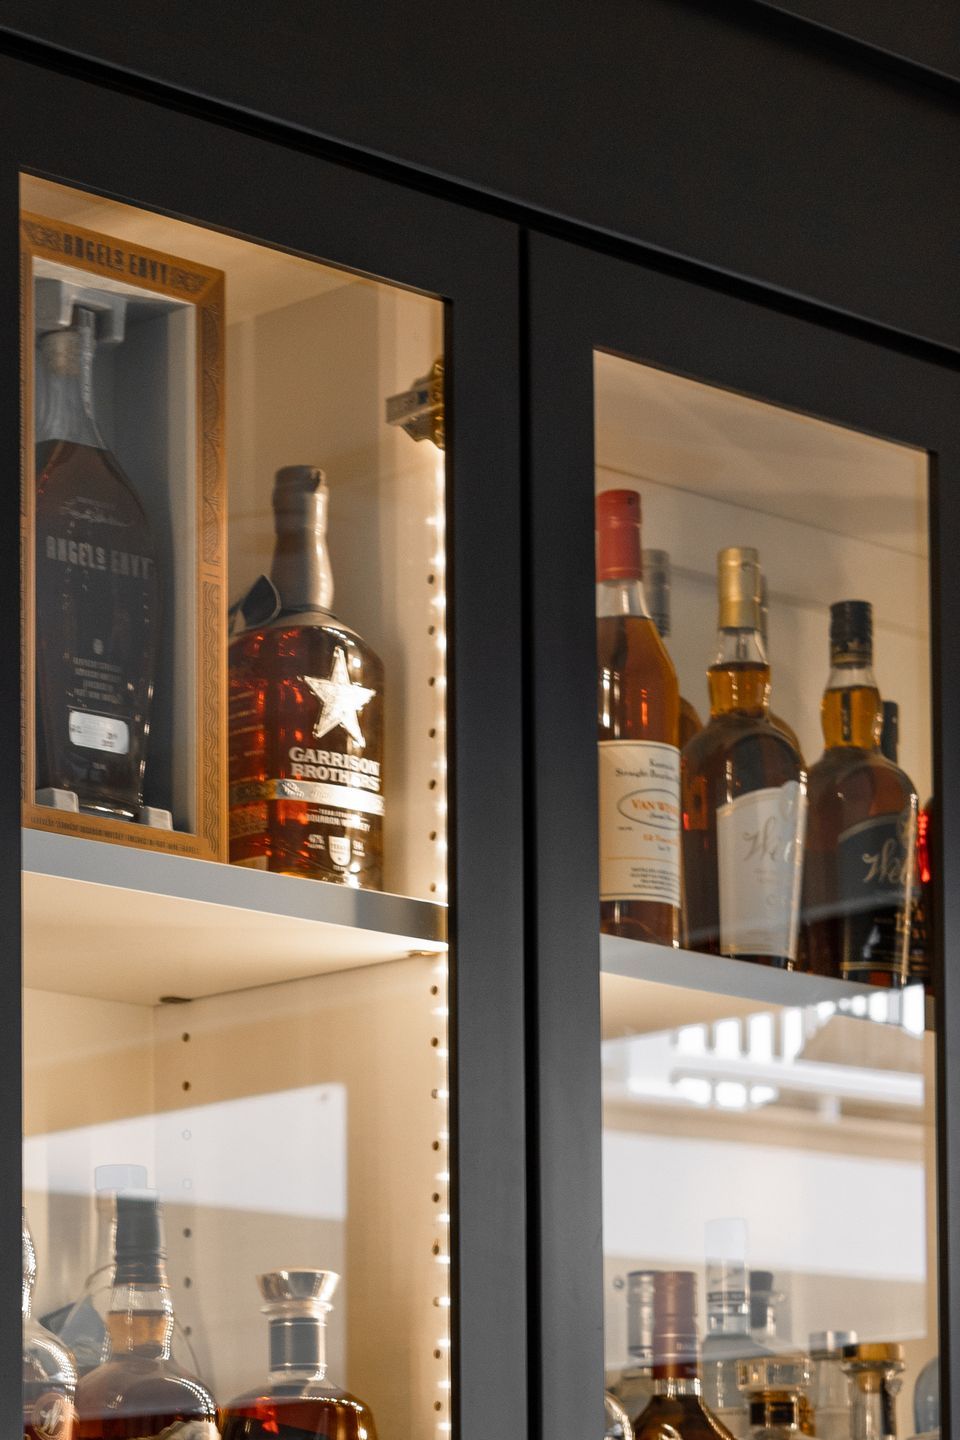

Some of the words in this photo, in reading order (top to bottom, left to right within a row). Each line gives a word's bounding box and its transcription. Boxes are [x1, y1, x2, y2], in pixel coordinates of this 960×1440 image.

[129, 253, 168, 287] ENVY
[289, 747, 380, 777] GARRISON
[291, 763, 381, 791] BROTHERS
